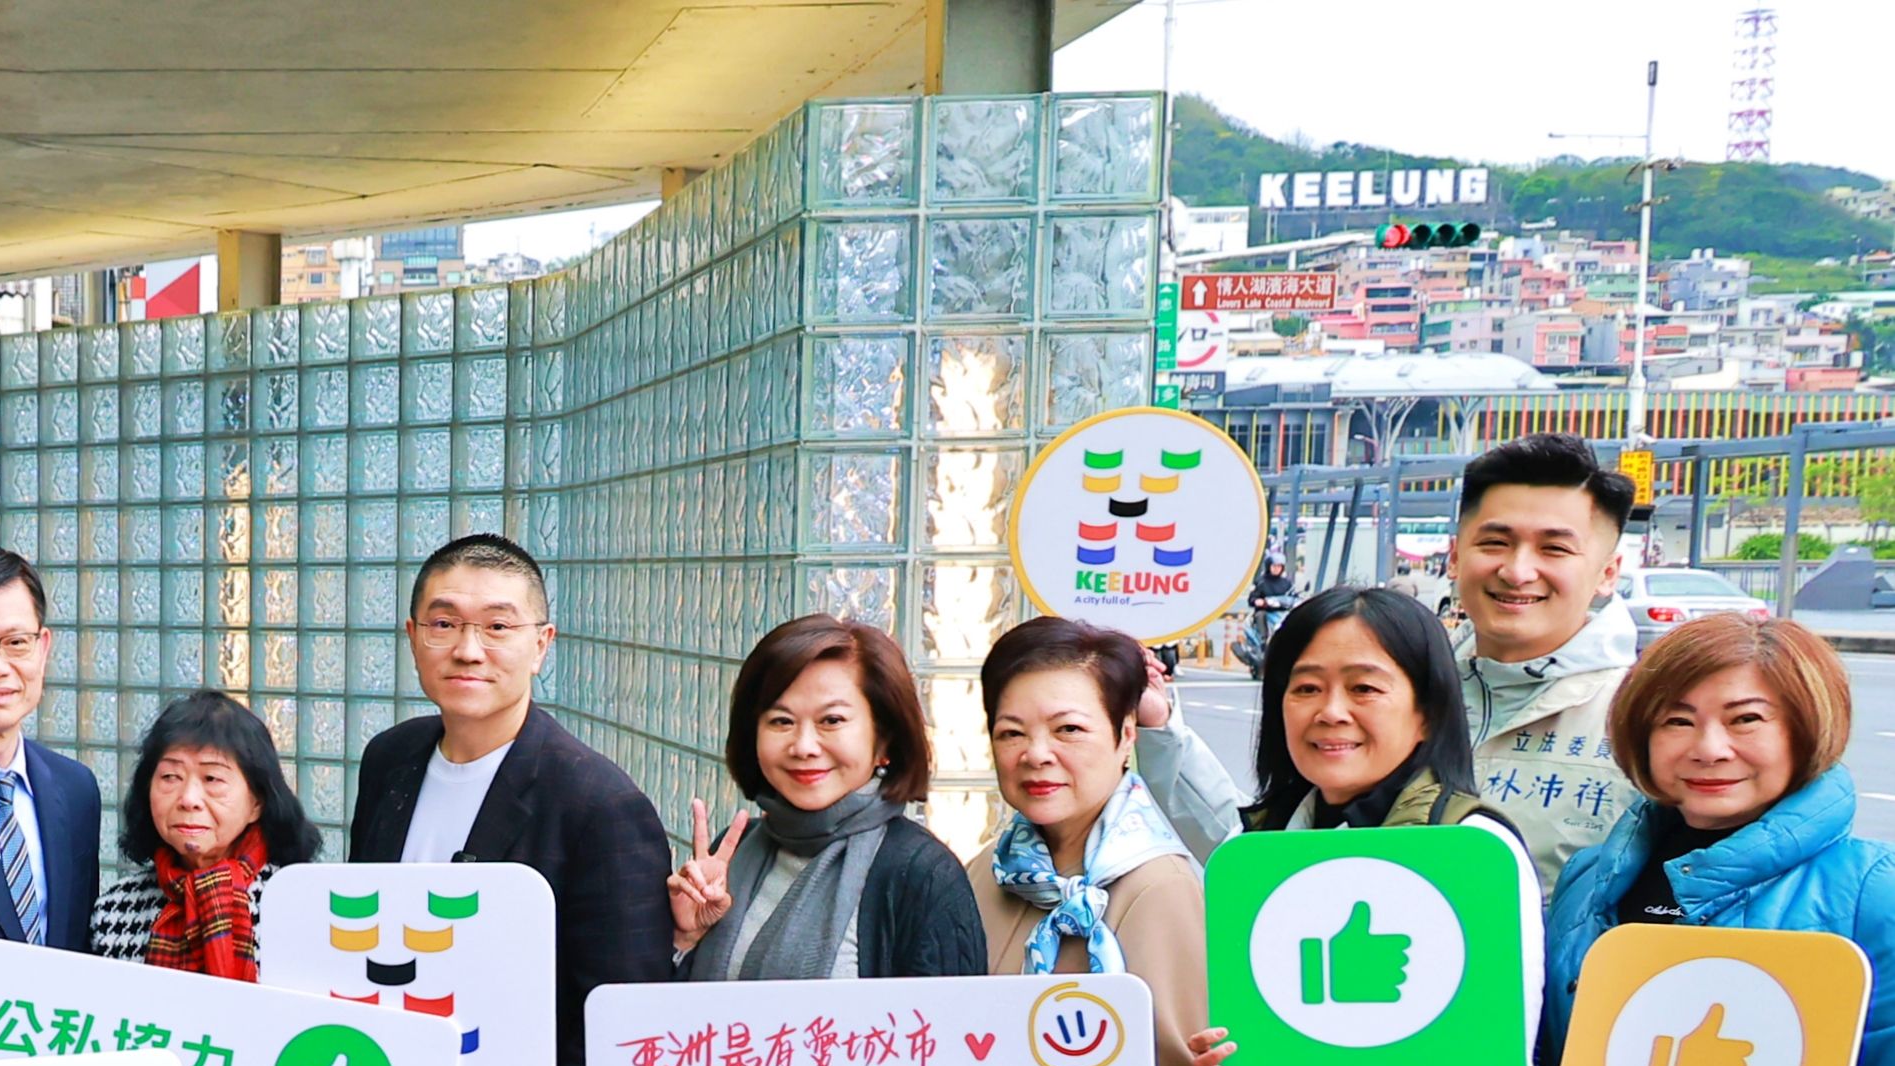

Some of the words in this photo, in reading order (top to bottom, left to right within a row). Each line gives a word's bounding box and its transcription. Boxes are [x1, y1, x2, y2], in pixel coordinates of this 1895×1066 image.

[1259, 168, 1488, 209] KEELUNG
[1217, 276, 1333, 296] 情人湖濱海大道
[1075, 570, 1190, 595] KEELUNG
[1074, 596, 1082, 604] A
[1083, 595, 1100, 606] city
[1102, 596, 1118, 605] full
[1119, 597, 1130, 605] of
[1511, 730, 1611, 760] 立法委員
[1482, 768, 1613, 816] 林沛祥
